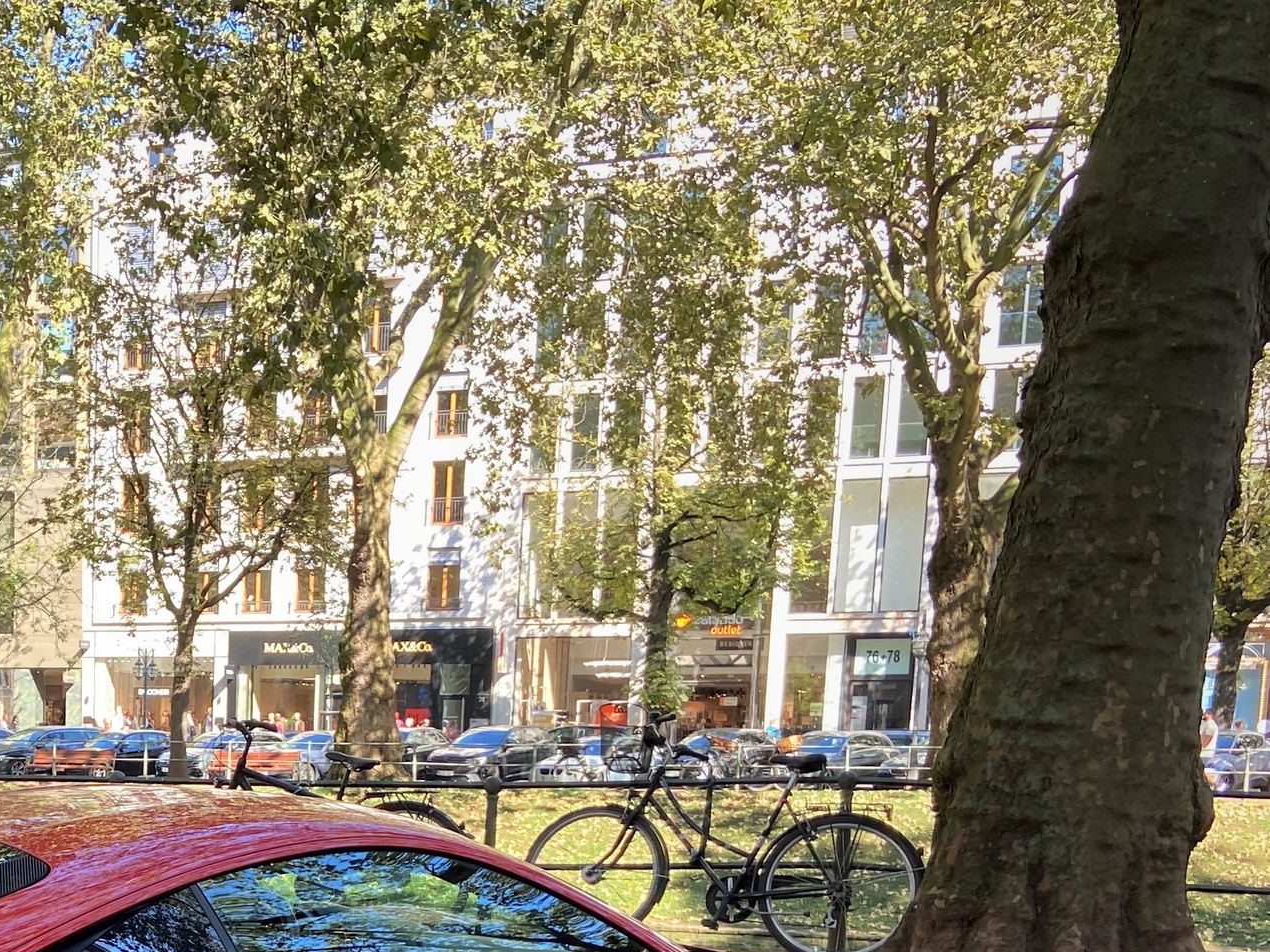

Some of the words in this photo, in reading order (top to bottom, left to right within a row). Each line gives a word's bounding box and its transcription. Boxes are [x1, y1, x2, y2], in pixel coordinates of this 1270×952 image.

[710, 625, 742, 635] outlet
[392, 641, 433, 652] AX&Co.
[866, 649, 901, 664] 76+78
